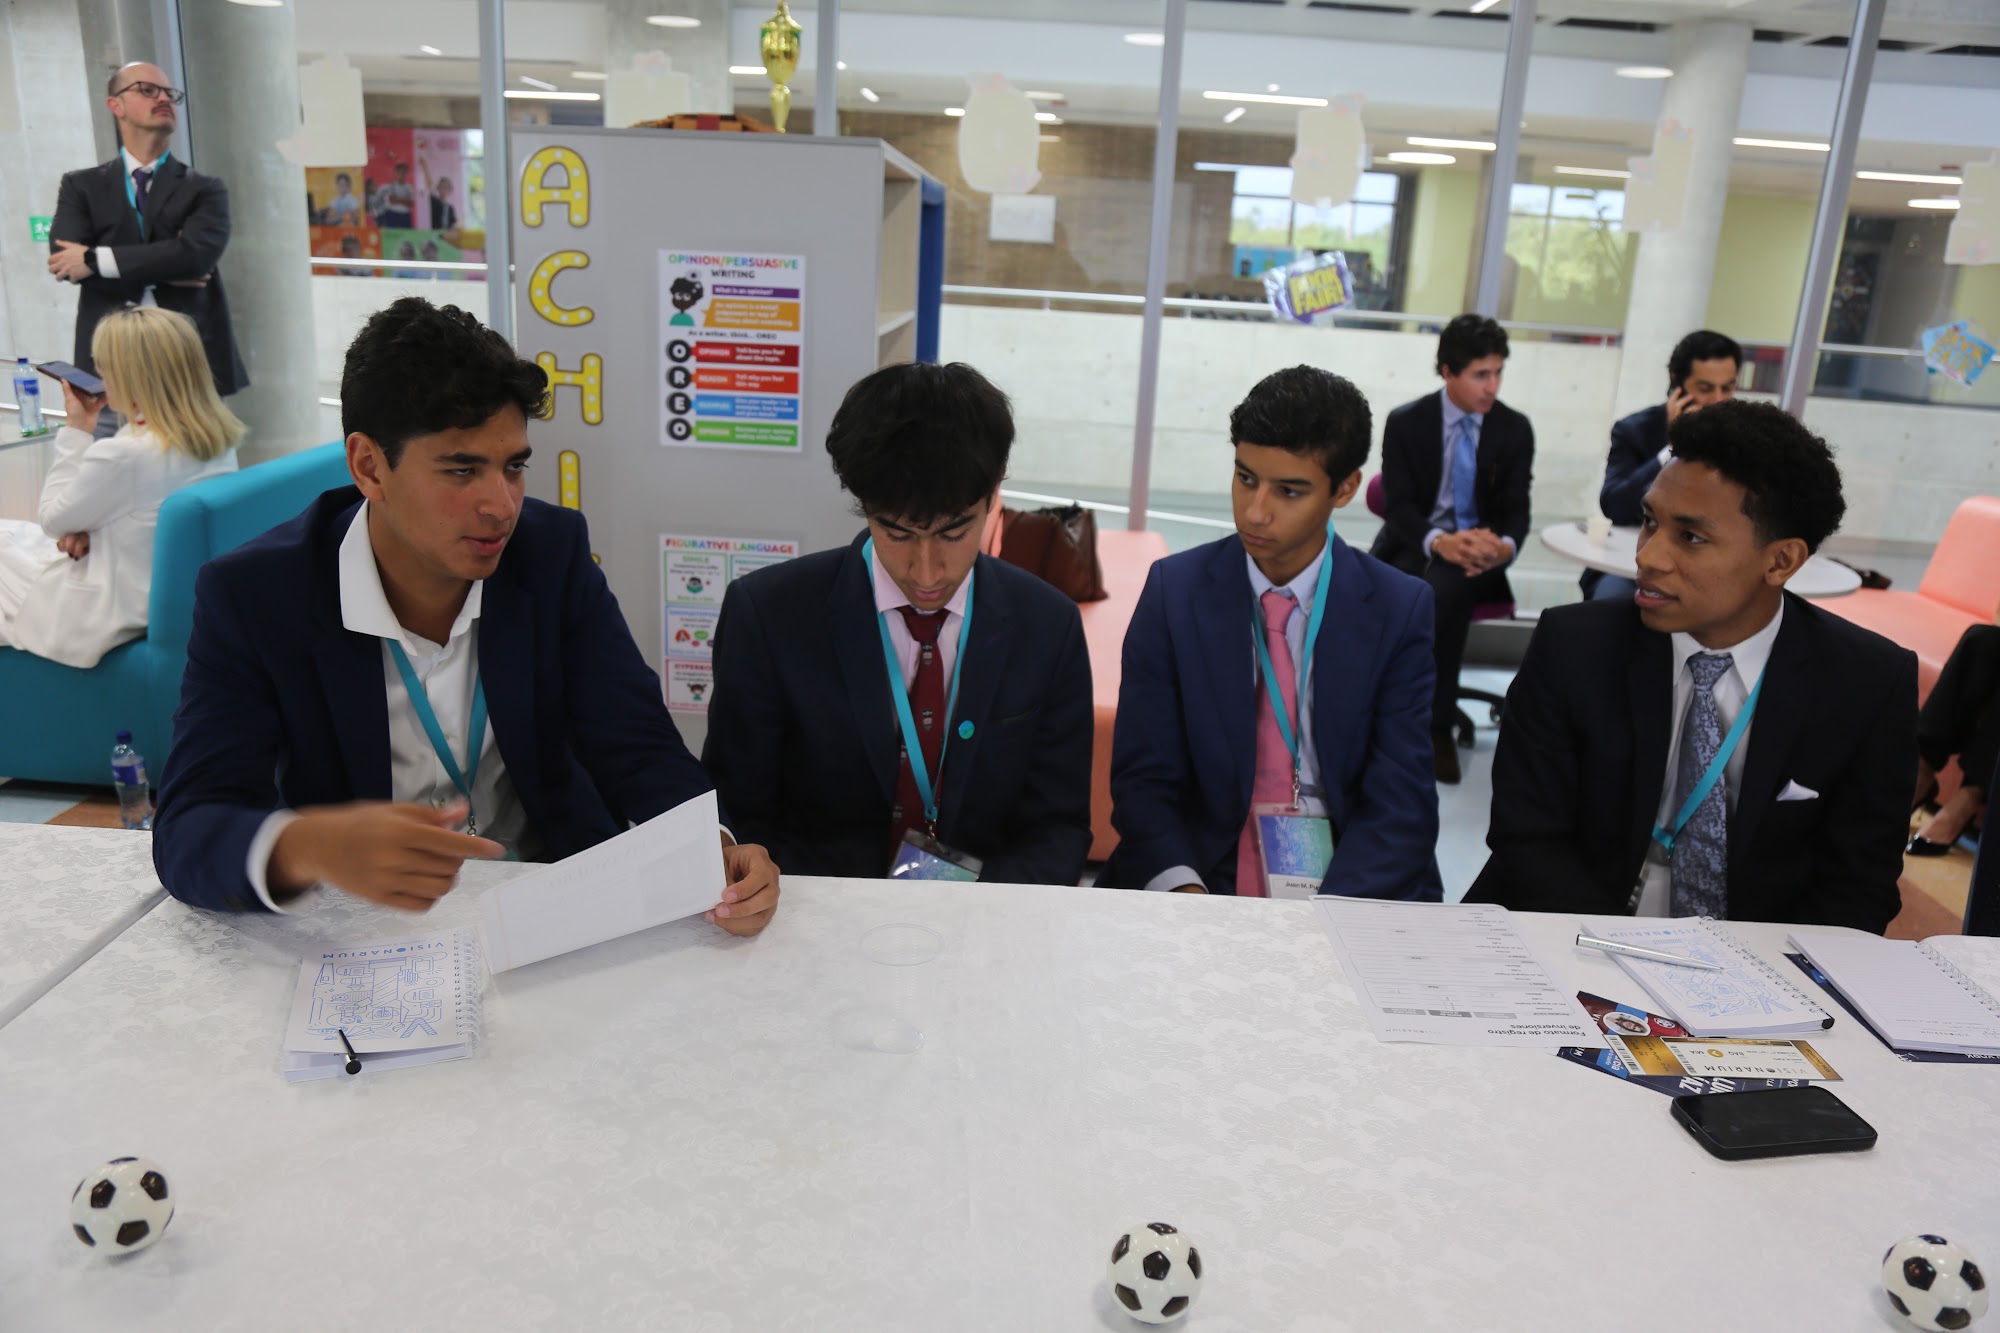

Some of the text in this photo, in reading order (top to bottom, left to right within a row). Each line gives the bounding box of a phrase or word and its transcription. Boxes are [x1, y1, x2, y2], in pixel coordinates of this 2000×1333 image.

[667, 254, 799, 269] OPINION/PERSUASIVE
[711, 269, 755, 279] WRITING
[1289, 264, 1338, 292] BOOK
[665, 538, 793, 554] FIGURATIVE LANGUAGE
[1285, 881, 1300, 889] Juan
[322, 942, 444, 959] VISIONARIUM
[1543, 1029, 1586, 1037] Formato
[1704, 1064, 1809, 1075] VISIONARIUM
